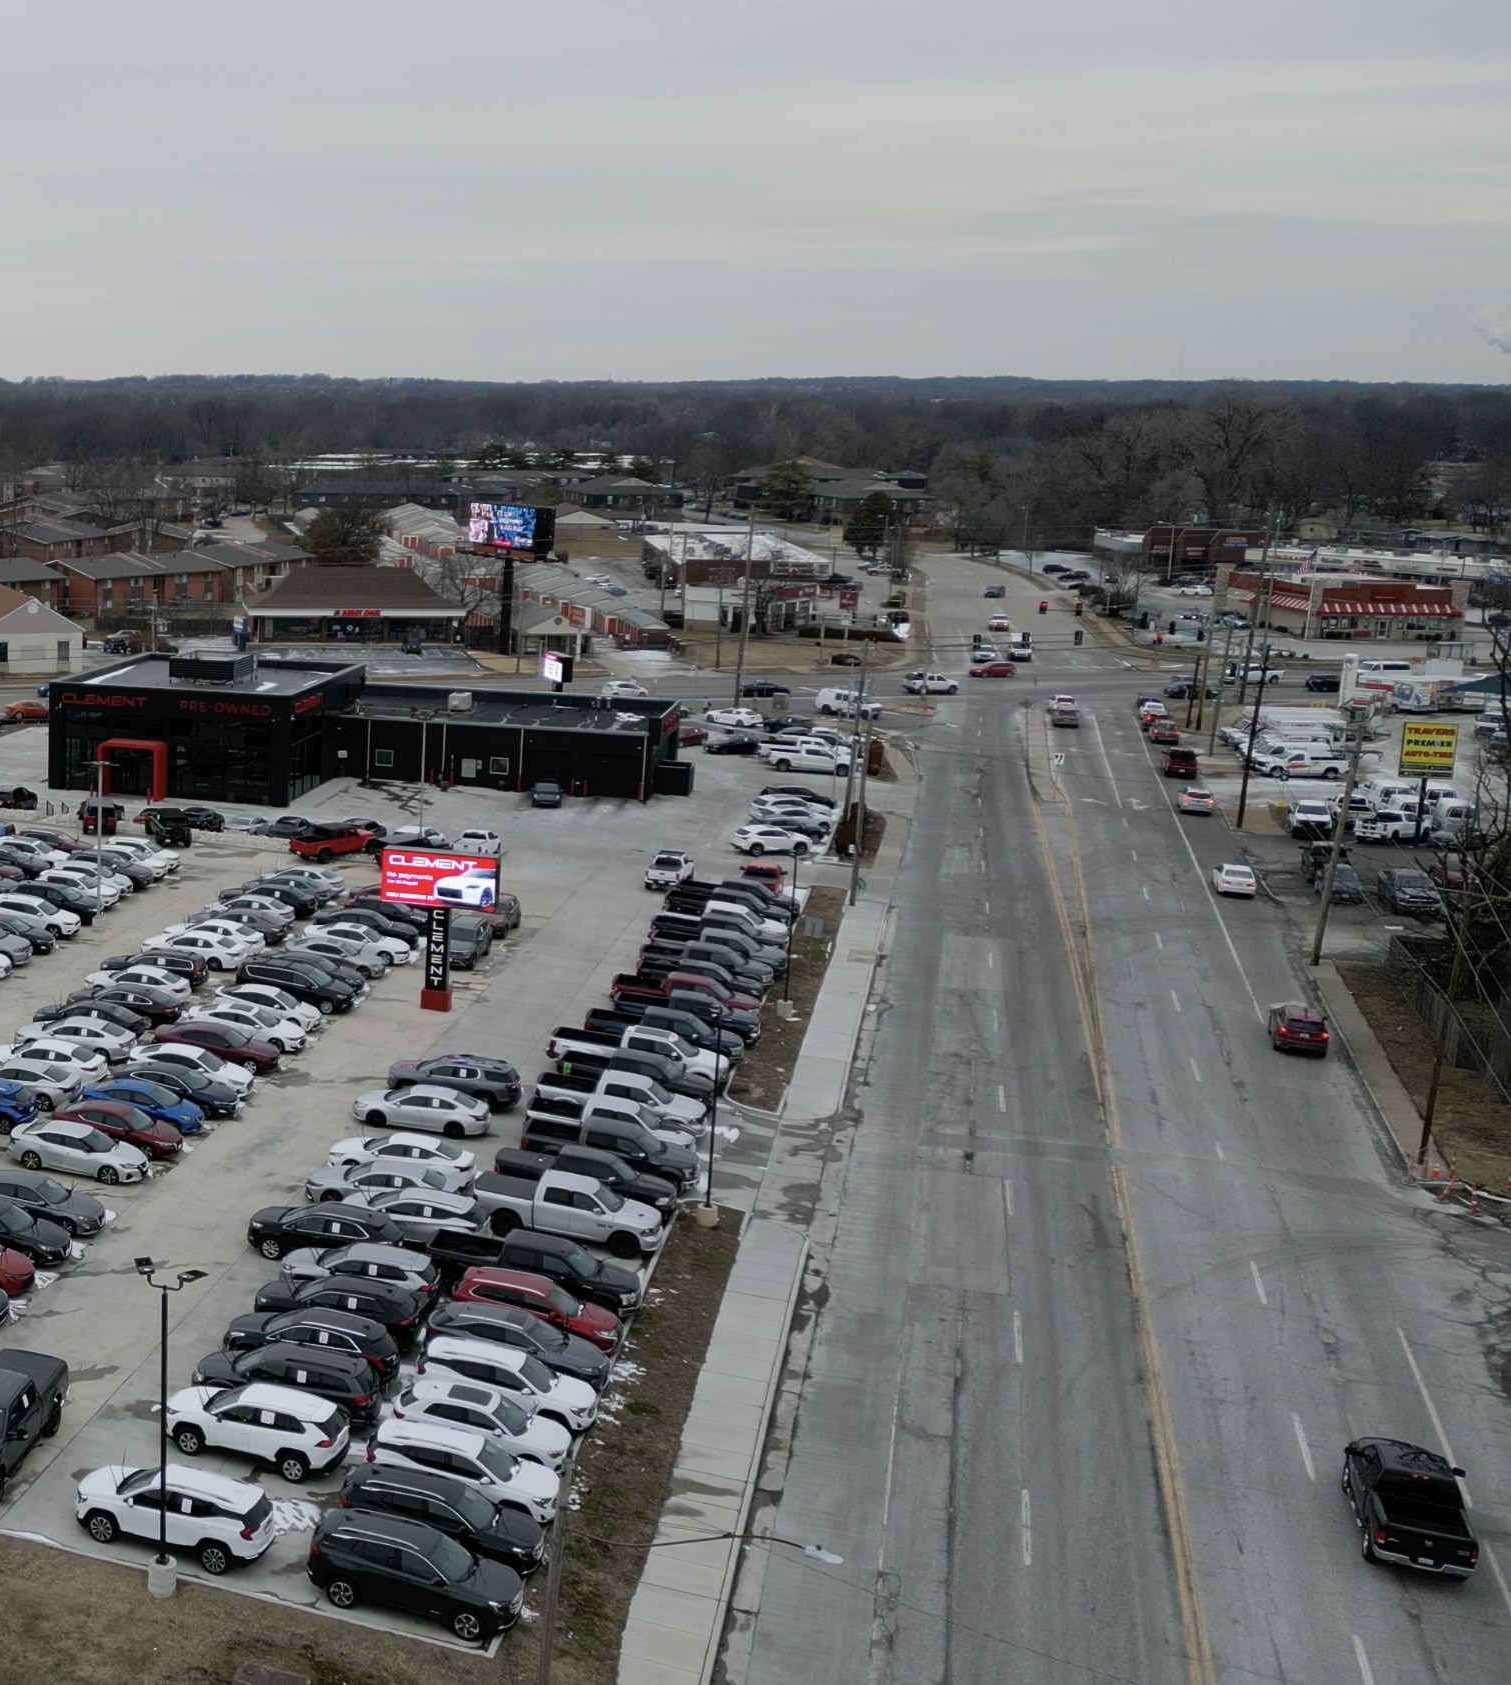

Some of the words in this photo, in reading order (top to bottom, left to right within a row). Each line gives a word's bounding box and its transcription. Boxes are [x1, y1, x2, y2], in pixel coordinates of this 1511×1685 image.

[61, 692, 147, 709] CLEMENT
[179, 700, 272, 717] PRE-OWNED
[1407, 728, 1456, 736] TRAVERS
[1404, 750, 1453, 758] AUTO-TIRE
[389, 854, 478, 871] CLEMENT
[430, 910, 444, 986] CLEMENT
